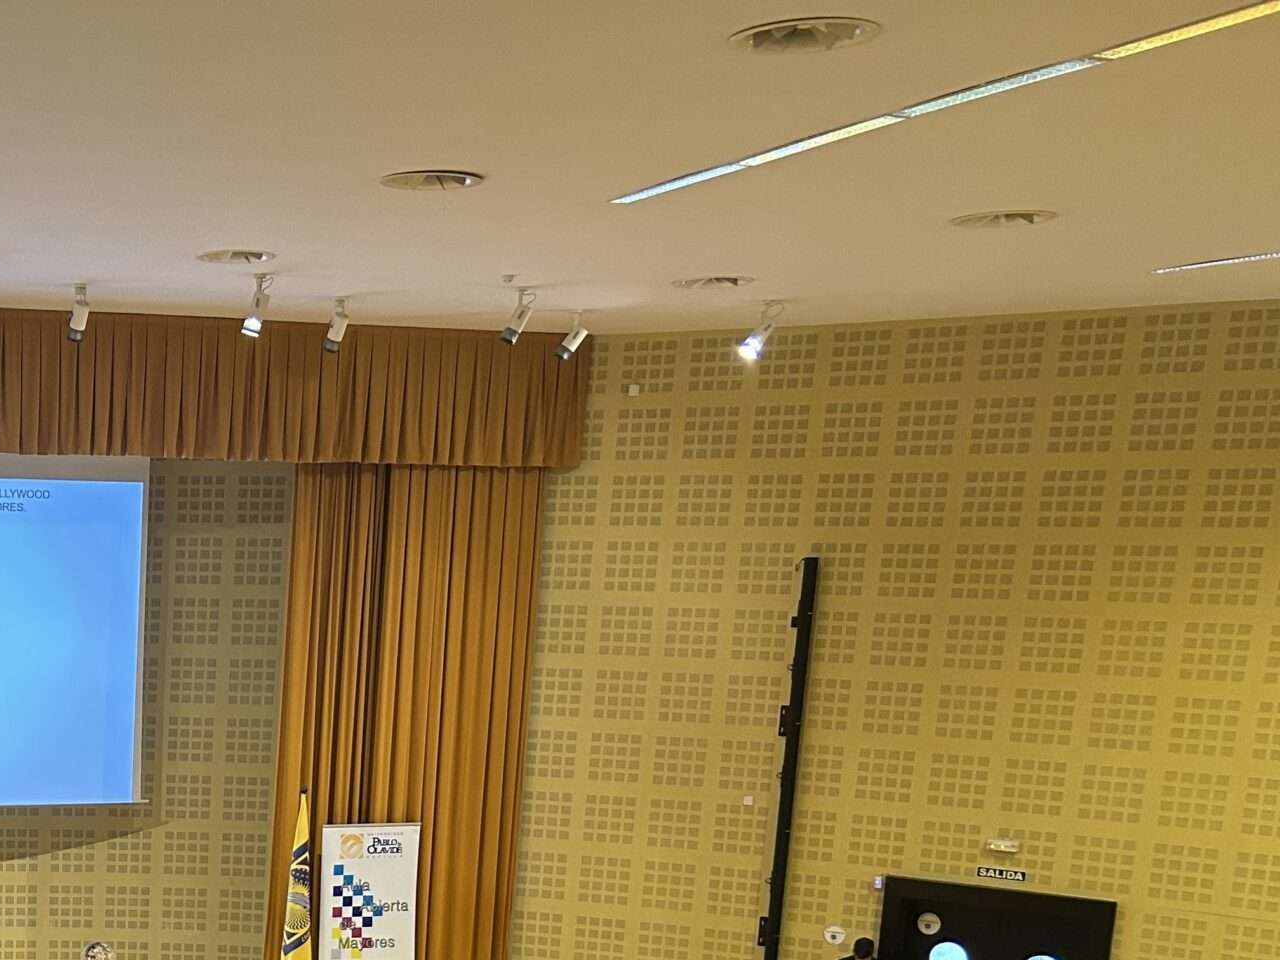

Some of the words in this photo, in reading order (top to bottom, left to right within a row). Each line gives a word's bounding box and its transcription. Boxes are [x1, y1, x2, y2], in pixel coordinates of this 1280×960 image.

[372, 837, 398, 846] PABLO
[367, 845, 403, 854] OLAVIDE
[979, 868, 1023, 880] SALIDA
[338, 937, 396, 951] Mayores
